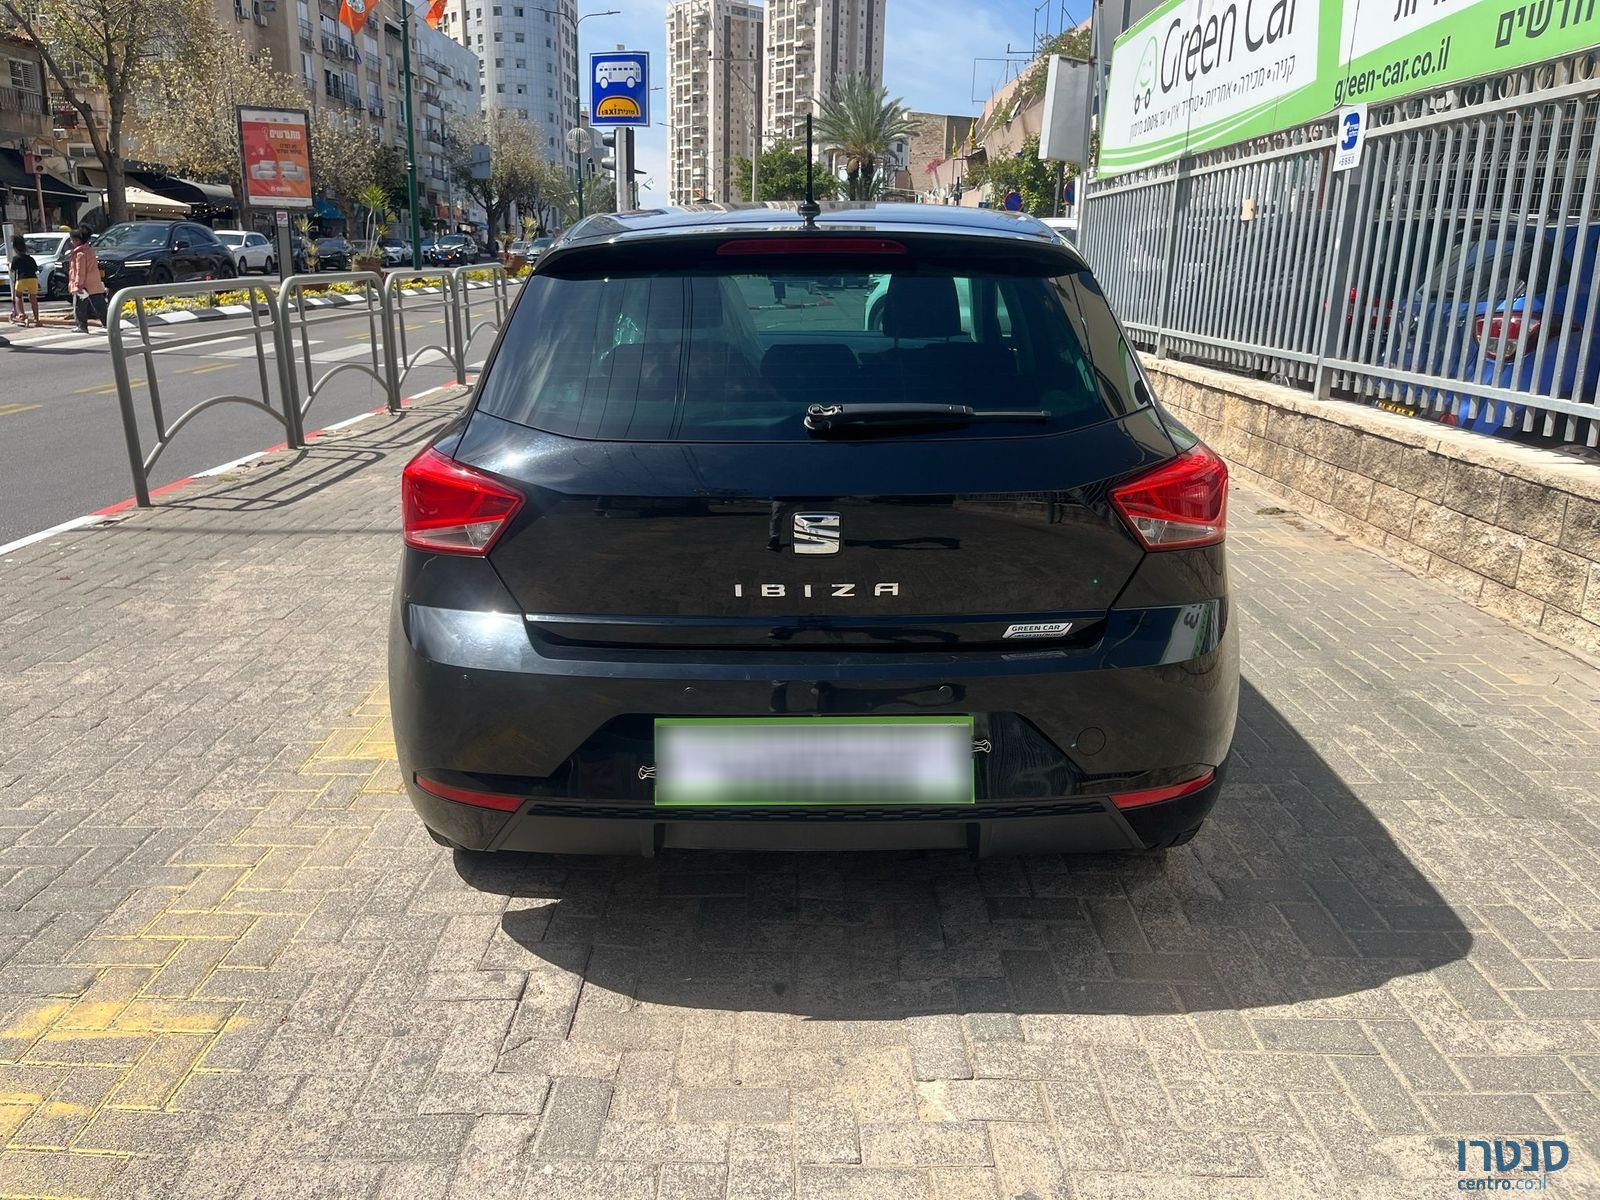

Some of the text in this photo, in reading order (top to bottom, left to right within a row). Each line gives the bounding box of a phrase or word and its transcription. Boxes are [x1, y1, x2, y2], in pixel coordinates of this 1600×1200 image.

[1161, 3, 1237, 94] Green
[1334, 36, 1451, 107] green-car.co.il
[734, 583, 899, 598] IBIZA
